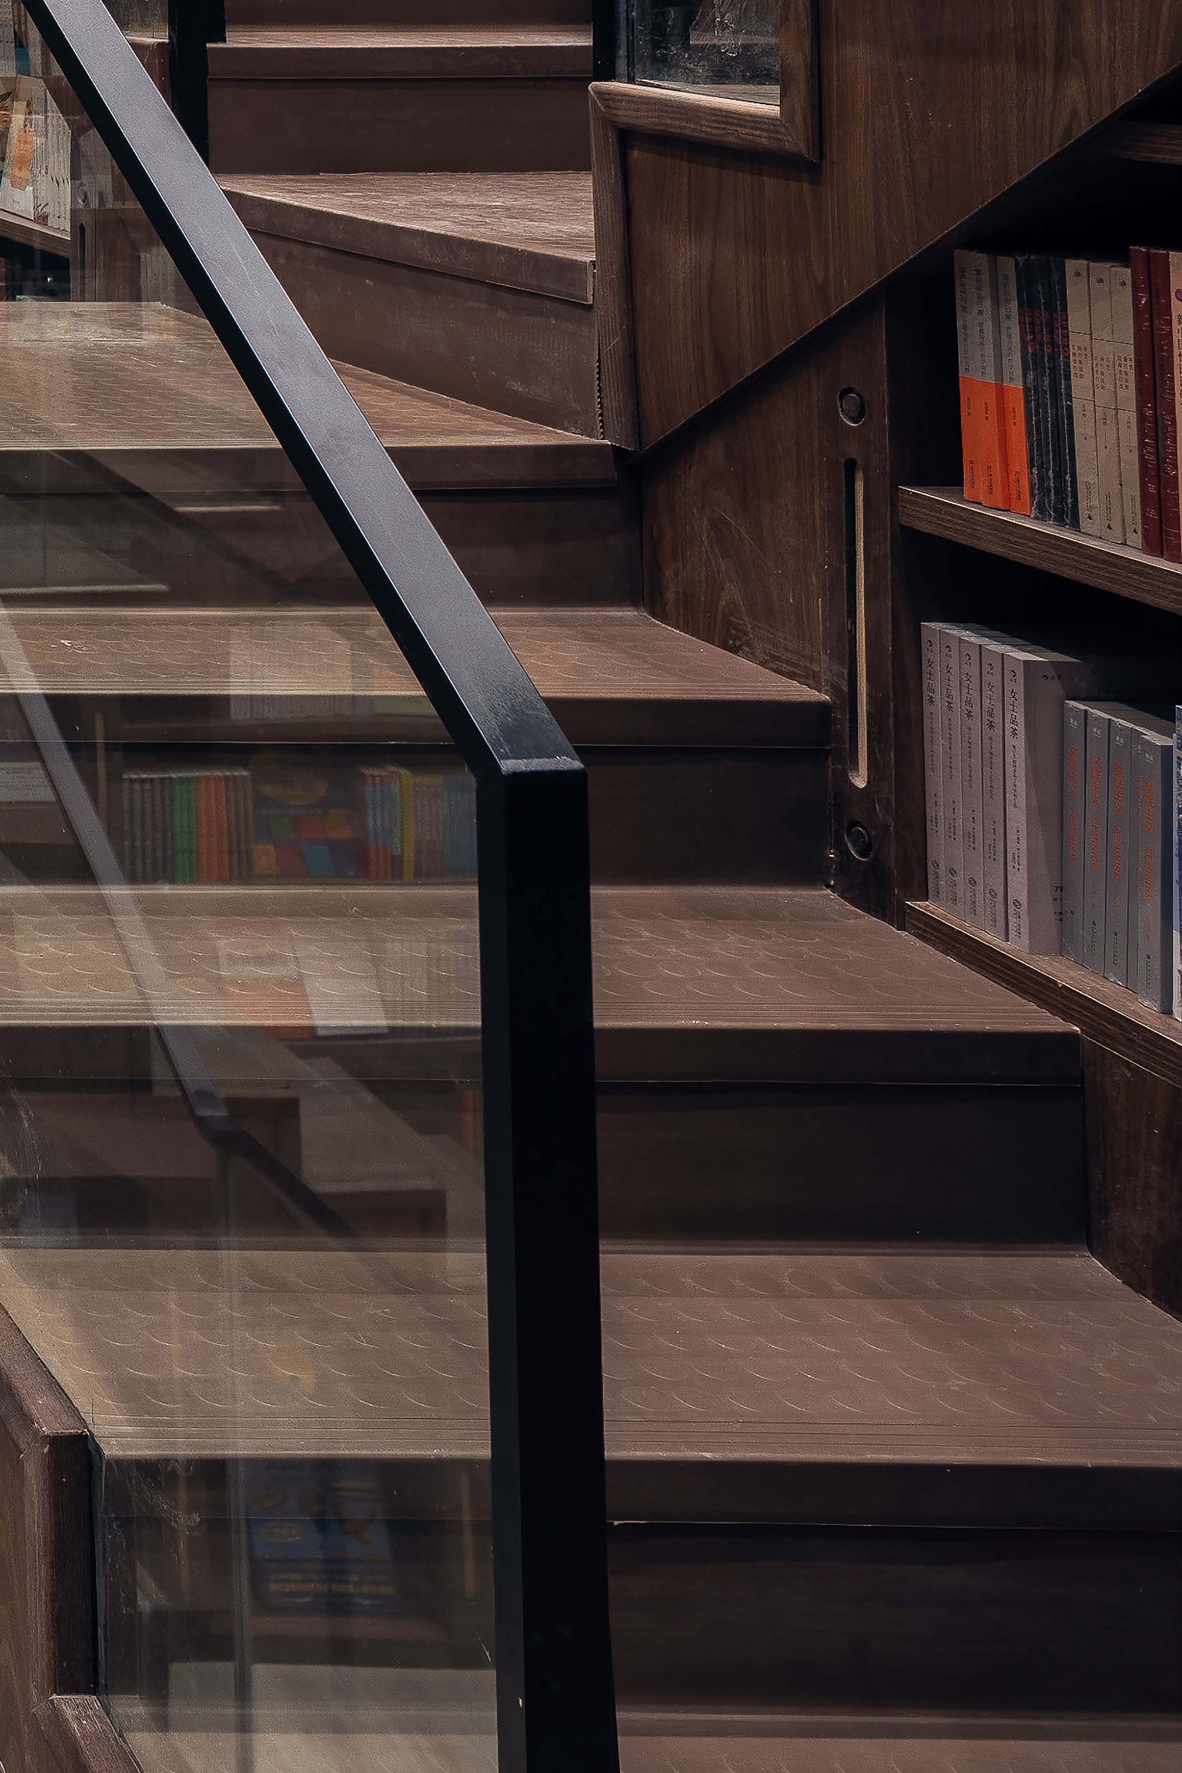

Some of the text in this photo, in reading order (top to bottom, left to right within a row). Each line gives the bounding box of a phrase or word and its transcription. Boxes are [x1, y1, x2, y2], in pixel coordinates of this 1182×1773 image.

[926, 657, 936, 706] 女士品茶
[944, 663, 954, 713] 女士品茶
[964, 671, 974, 721] 女士品茶
[986, 681, 996, 732] 女士品茶
[1009, 688, 1019, 739] 女士品茶
[1091, 818, 1099, 873] FEMINISM
[1113, 826, 1122, 882] FEMINISM
[1144, 845, 1153, 904] FEMINISM
